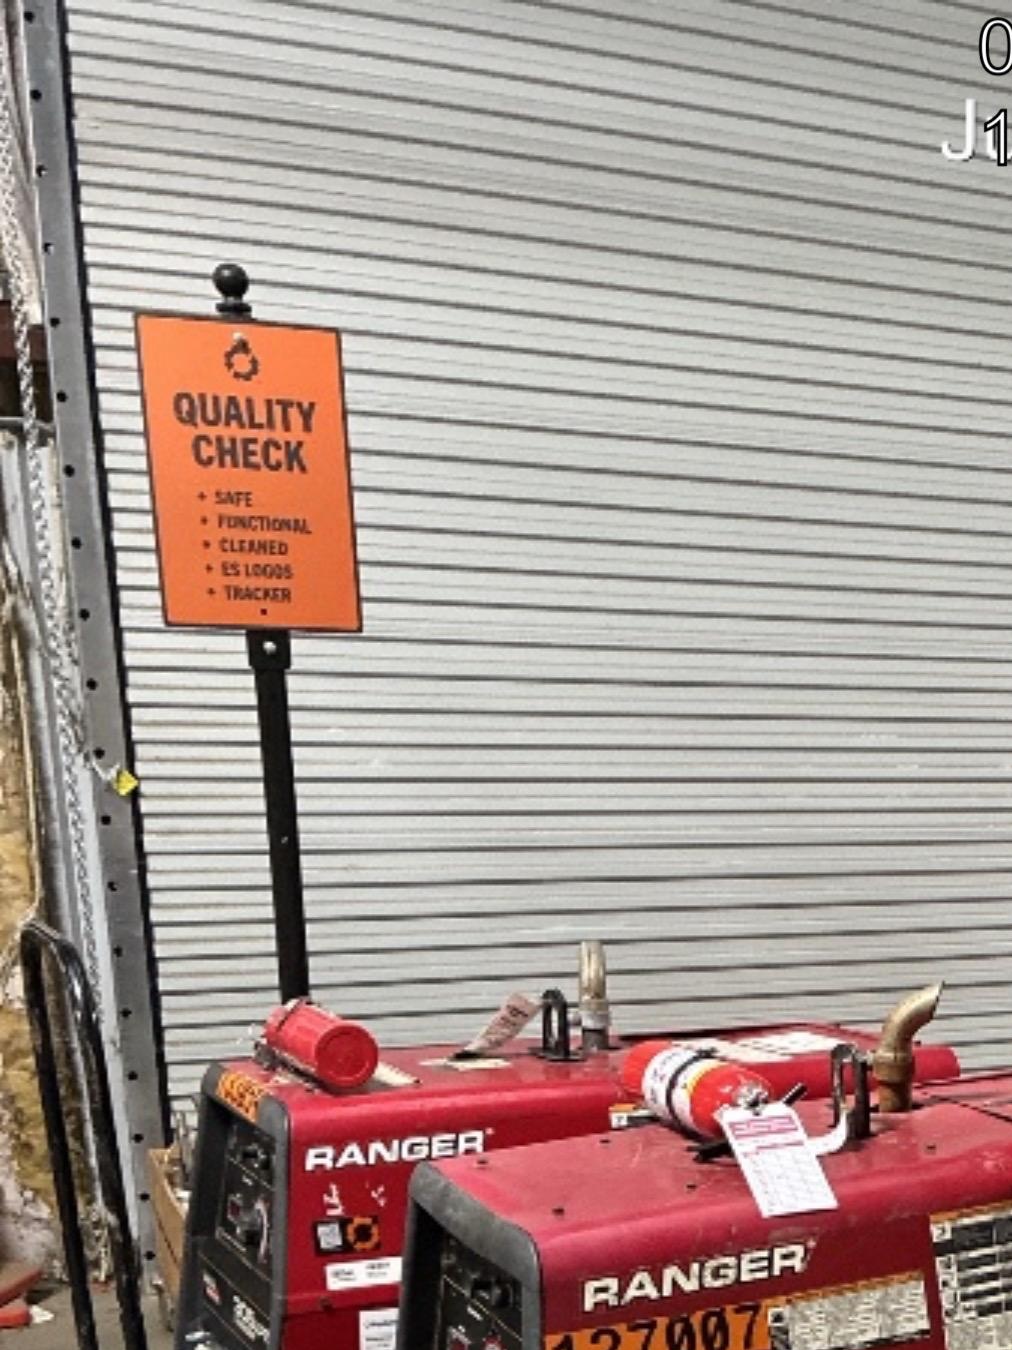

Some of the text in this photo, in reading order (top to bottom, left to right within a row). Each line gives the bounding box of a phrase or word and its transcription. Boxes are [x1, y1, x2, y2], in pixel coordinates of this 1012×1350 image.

[173, 392, 315, 432] QUALITY
[191, 434, 307, 474] CHECK
[215, 490, 252, 507] SAFE
[218, 514, 312, 534] FUNCTIONAL
[220, 537, 288, 555] CLEANED
[224, 585, 292, 603] TRACKER
[304, 1130, 485, 1172] RANGER
[583, 1243, 806, 1312] RANGER
